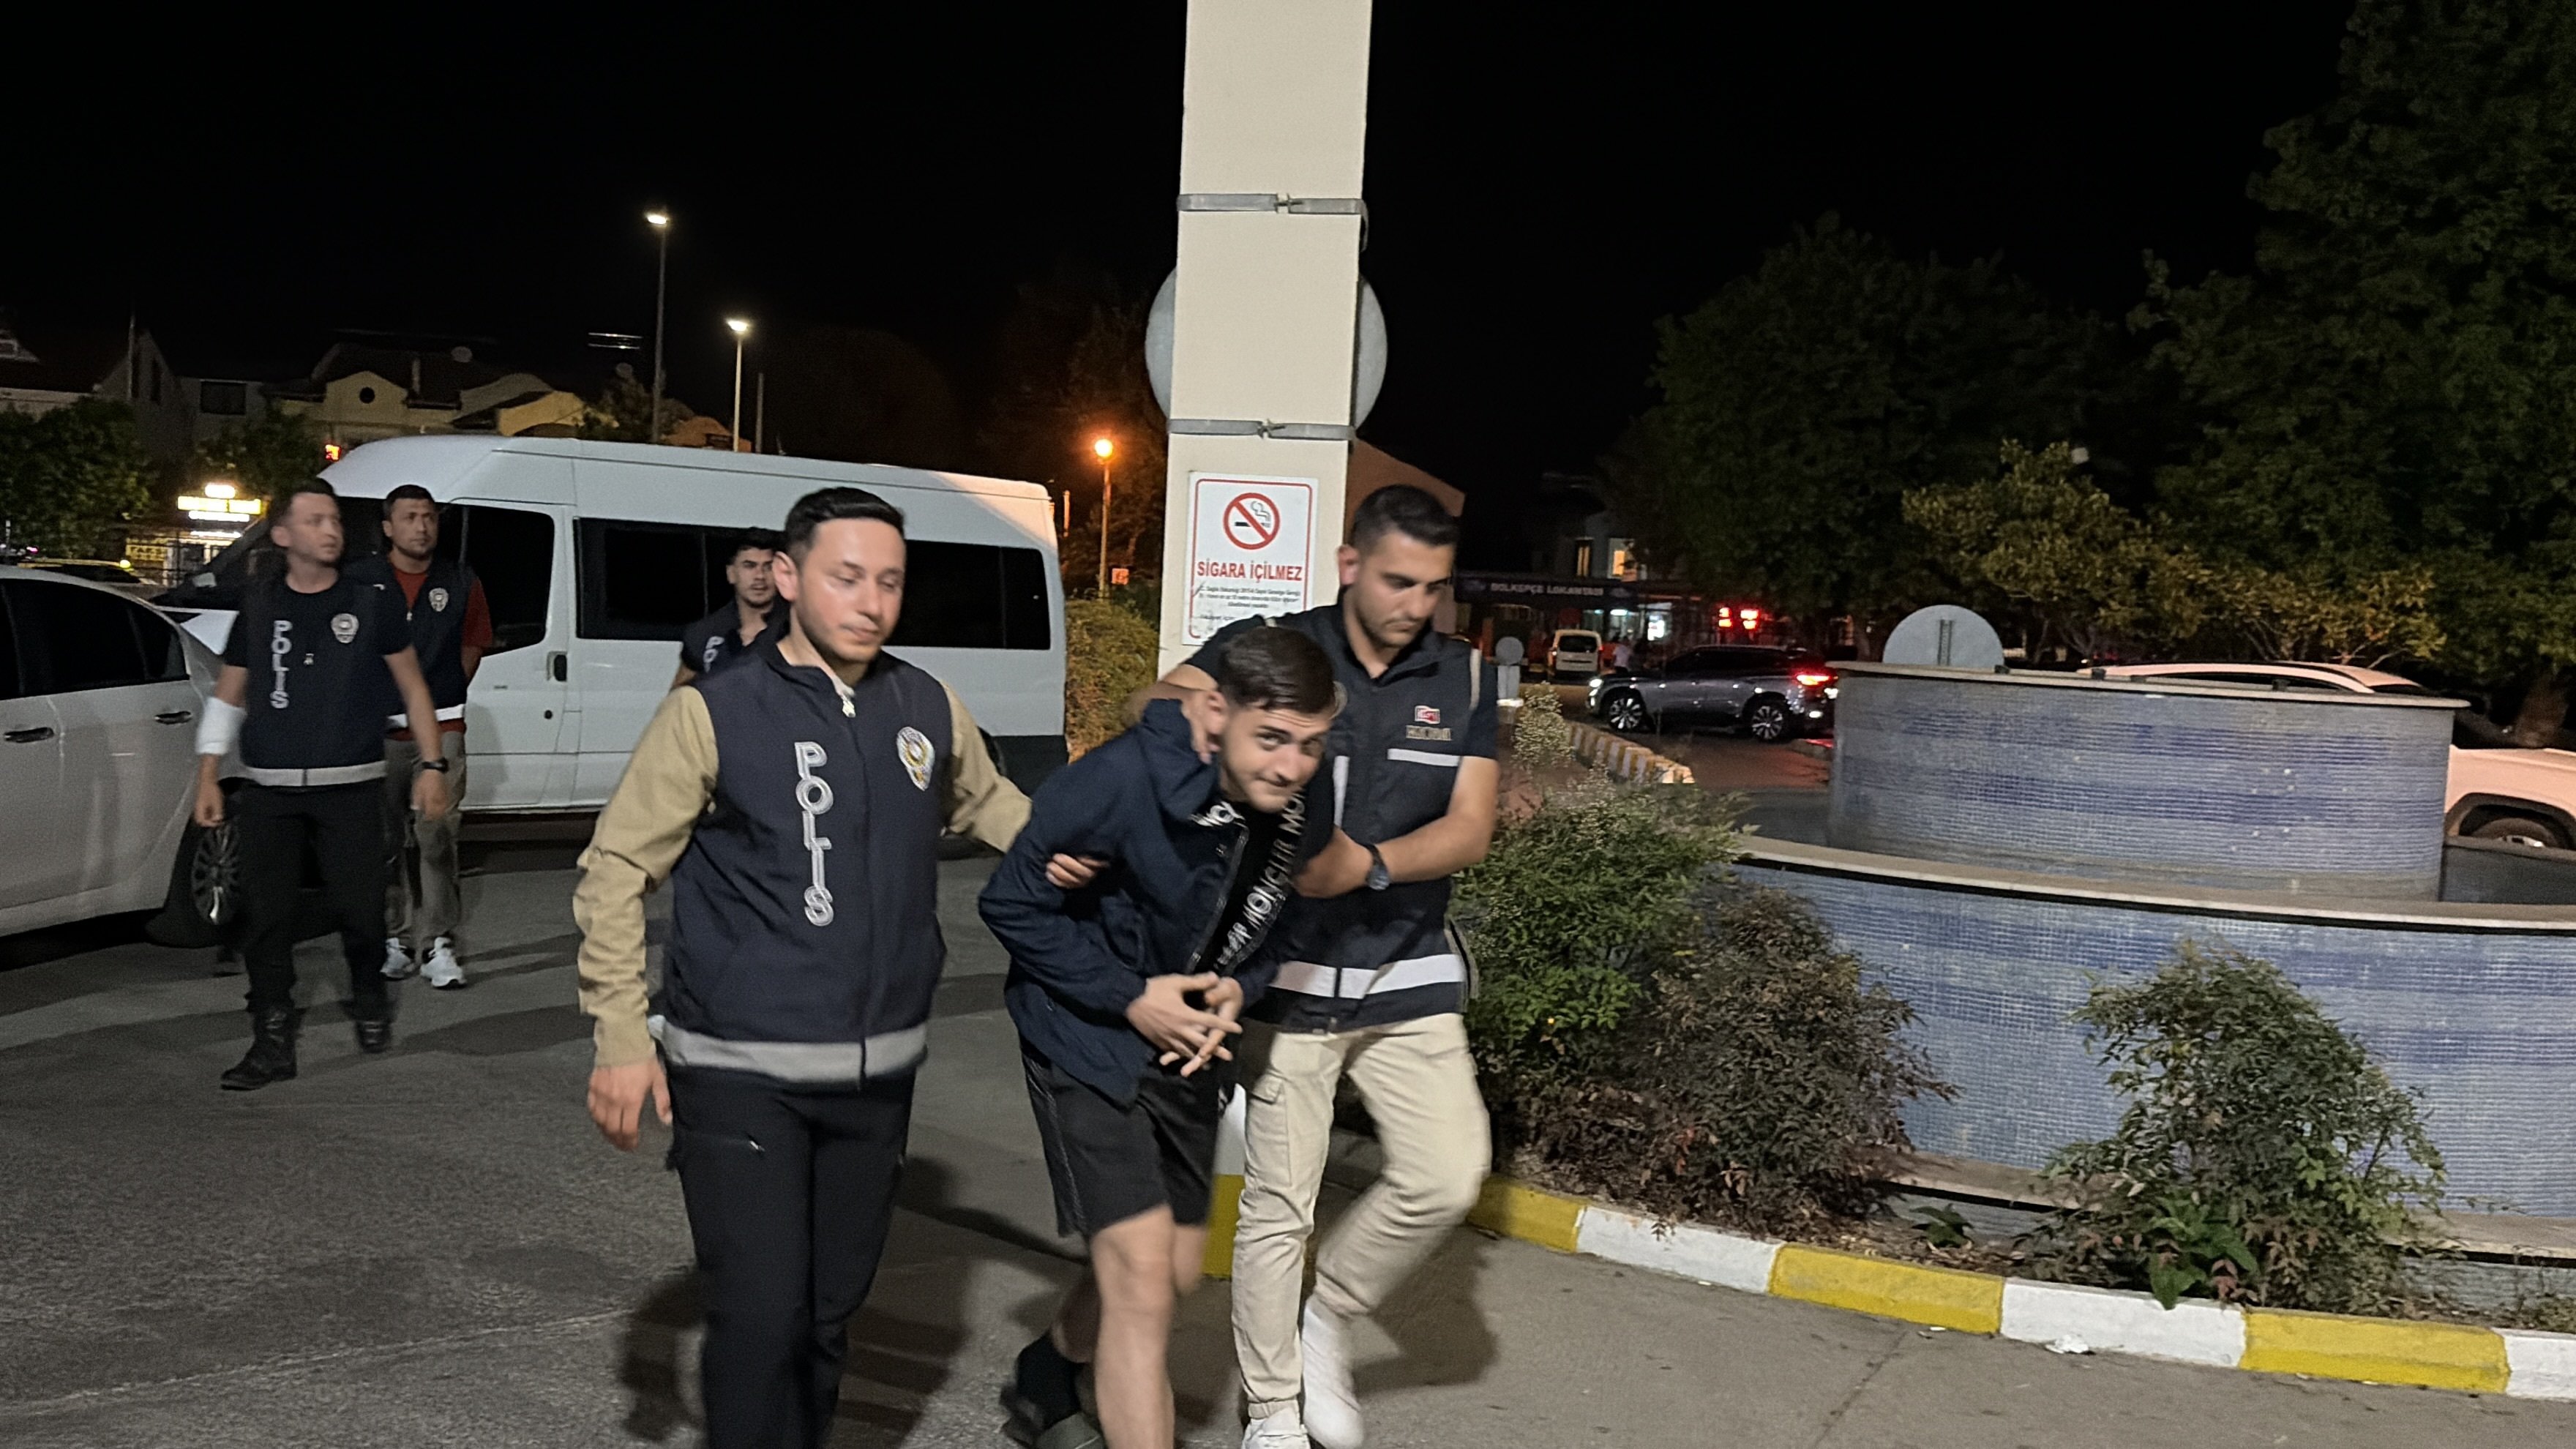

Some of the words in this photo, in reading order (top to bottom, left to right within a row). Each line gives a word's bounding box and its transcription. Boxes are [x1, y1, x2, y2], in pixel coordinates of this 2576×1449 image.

[1197, 558, 1246, 578] SİGARA
[1250, 561, 1303, 583] İÇİLMEZ
[269, 620, 293, 709] POLIS
[795, 741, 834, 926] POLIS
